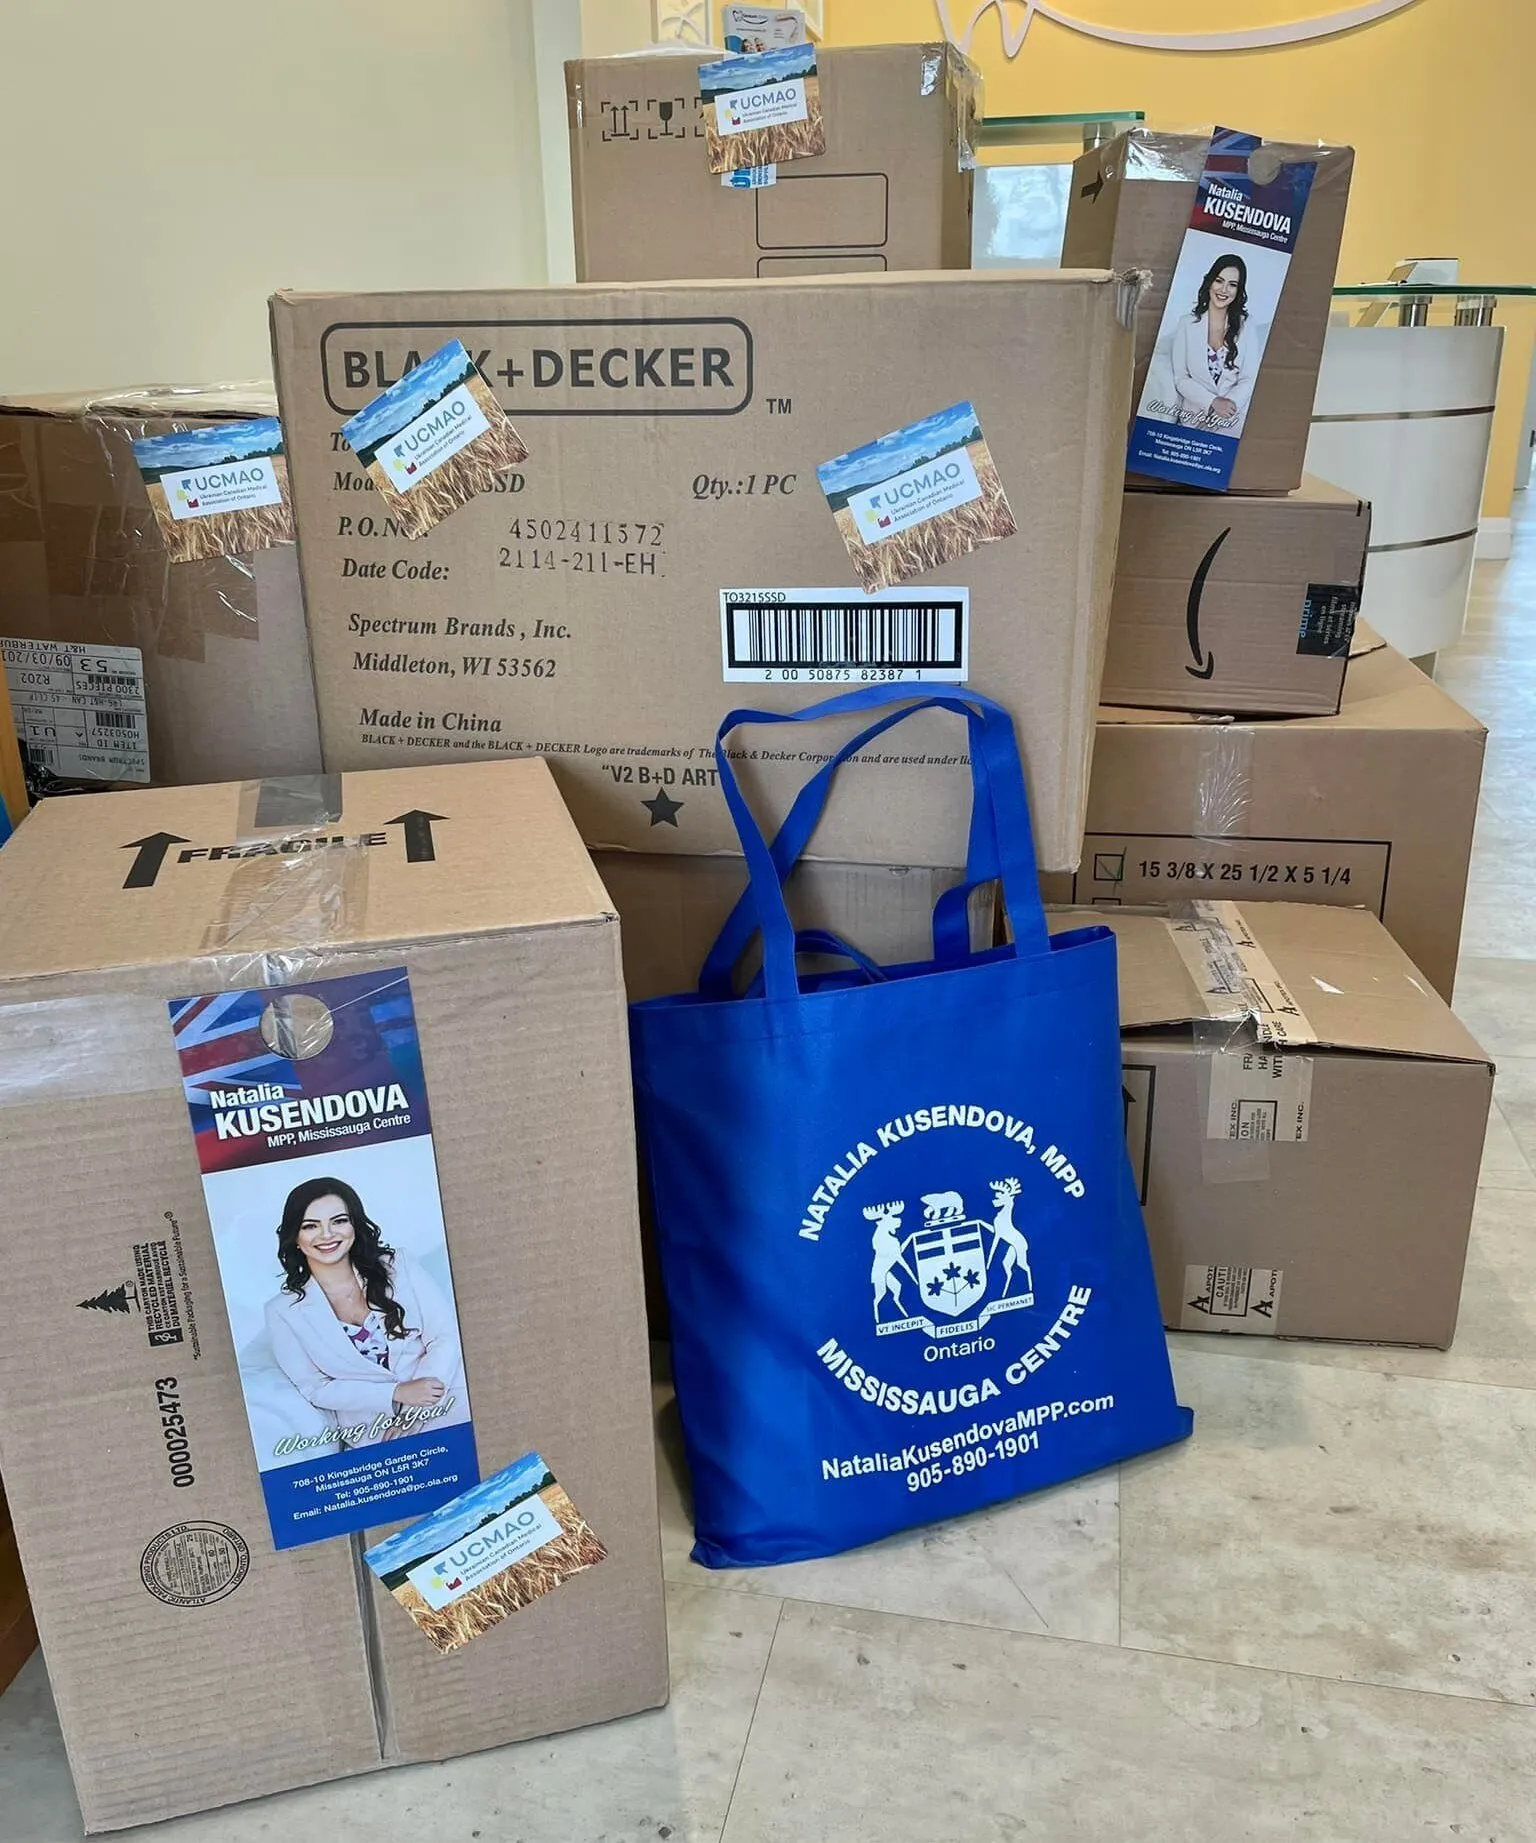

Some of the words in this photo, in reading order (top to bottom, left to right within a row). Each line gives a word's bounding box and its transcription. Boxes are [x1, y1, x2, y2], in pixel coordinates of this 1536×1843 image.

[740, 88, 797, 109] UCMAO
[1208, 183, 1243, 202] Natalia
[1203, 196, 1291, 234] KUSENDOVA
[766, 398, 792, 414] TM
[404, 401, 465, 451] UCMAO
[194, 467, 265, 491] UCMAO
[761, 474, 797, 495] PC
[884, 462, 960, 505] UCMAO
[509, 517, 665, 546] 4502411572
[342, 557, 387, 579] Date
[391, 559, 450, 580] Code:
[348, 613, 437, 637] Spectrum
[444, 617, 516, 638] Brands
[532, 619, 571, 639] Inc.
[352, 651, 456, 678] Middleton,
[462, 656, 491, 676] WI
[496, 657, 557, 678] 53562
[765, 669, 772, 680] 2
[782, 669, 798, 680] 00
[809, 669, 850, 680] 50875
[861, 669, 904, 680] 82387
[915, 669, 922, 680] 1
[20, 672, 50, 685] R202
[75, 680, 113, 693] PIECES
[114, 684, 140, 696] 2300
[359, 707, 412, 729] Made
[417, 711, 436, 730] in
[441, 711, 502, 733] China
[96, 739, 108, 748] ID
[113, 741, 137, 749] ITEM
[361, 734, 396, 746] BLACK
[406, 737, 451, 748] DECKER
[453, 739, 470, 749] and
[471, 739, 486, 750] the
[488, 740, 524, 751] BLACK
[535, 742, 580, 754] DECKER
[583, 744, 608, 757] Logo
[627, 747, 681, 757] trademarks
[683, 748, 695, 760] of
[750, 750, 759, 759] &
[760, 750, 796, 761] Decker
[861, 754, 881, 763] and
[901, 755, 926, 764] used
[927, 755, 958, 764] under
[639, 767, 675, 784] B+D
[1138, 861, 1161, 878] 15
[1166, 861, 1196, 878] 3/8
[1203, 863, 1215, 879] X
[1220, 863, 1243, 880] 25
[1250, 864, 1278, 882] 1/2
[1284, 866, 1297, 882] X
[1303, 867, 1314, 883] 5
[1321, 868, 1351, 885] 1/4
[209, 1083, 285, 1109] Natalia
[214, 1083, 409, 1140] KUSENDOVA
[1296, 1101, 1304, 1124] INC.
[267, 1132, 297, 1148] MPP,
[298, 1122, 371, 1143] Mississauga
[372, 1113, 411, 1130] Centre
[798, 1141, 879, 1242] NATALIA
[875, 1104, 1037, 1155] KUSENDOVA,
[1039, 1144, 1086, 1199] MPP
[141, 1242, 156, 1286] MATERIAL
[139, 1271, 147, 1288] MADE
[181, 1282, 190, 1292] for
[148, 1287, 163, 1330] RECYCLED
[184, 1291, 196, 1323] Packaging
[997, 1296, 1033, 1310] PERMANET
[172, 1315, 181, 1327] DU
[892, 1318, 925, 1332] INCEPIT
[939, 1323, 975, 1335] FIDELIS
[816, 1337, 1001, 1416] MISSISSAUGA
[1005, 1284, 1092, 1385] CENTRE
[923, 1336, 996, 1362] Ontario
[154, 1376, 195, 1488] 000025473
[273, 1422, 366, 1457] Working
[368, 1413, 402, 1439] for
[399, 1396, 455, 1430] You!
[821, 1394, 1115, 1481] NataliaKusendovaMPP.com
[292, 1474, 326, 1490] 708-10
[327, 1461, 383, 1481] Kingsbridge
[384, 1451, 419, 1467] Garden
[419, 1445, 449, 1458] Circle,
[906, 1430, 1040, 1493] 905-890-1901
[315, 1474, 374, 1493] Mississauga
[374, 1469, 390, 1479] ON
[391, 1463, 410, 1475] L5R
[412, 1458, 430, 1470] 3K7
[335, 1489, 352, 1501] Tel:
[352, 1474, 415, 1497] 905-890-1901
[293, 1508, 322, 1521] Email:
[323, 1473, 459, 1513] Natalia.kusendova@pc.ola.org
[144, 1531, 172, 1565] PRODUCTS
[449, 1511, 535, 1567] UCMAO
[489, 1540, 518, 1559] Canadian
[517, 1523, 542, 1541] Medical
[465, 1557, 500, 1581] Association
[499, 1551, 508, 1560] of
[507, 1539, 531, 1555] Ontario
